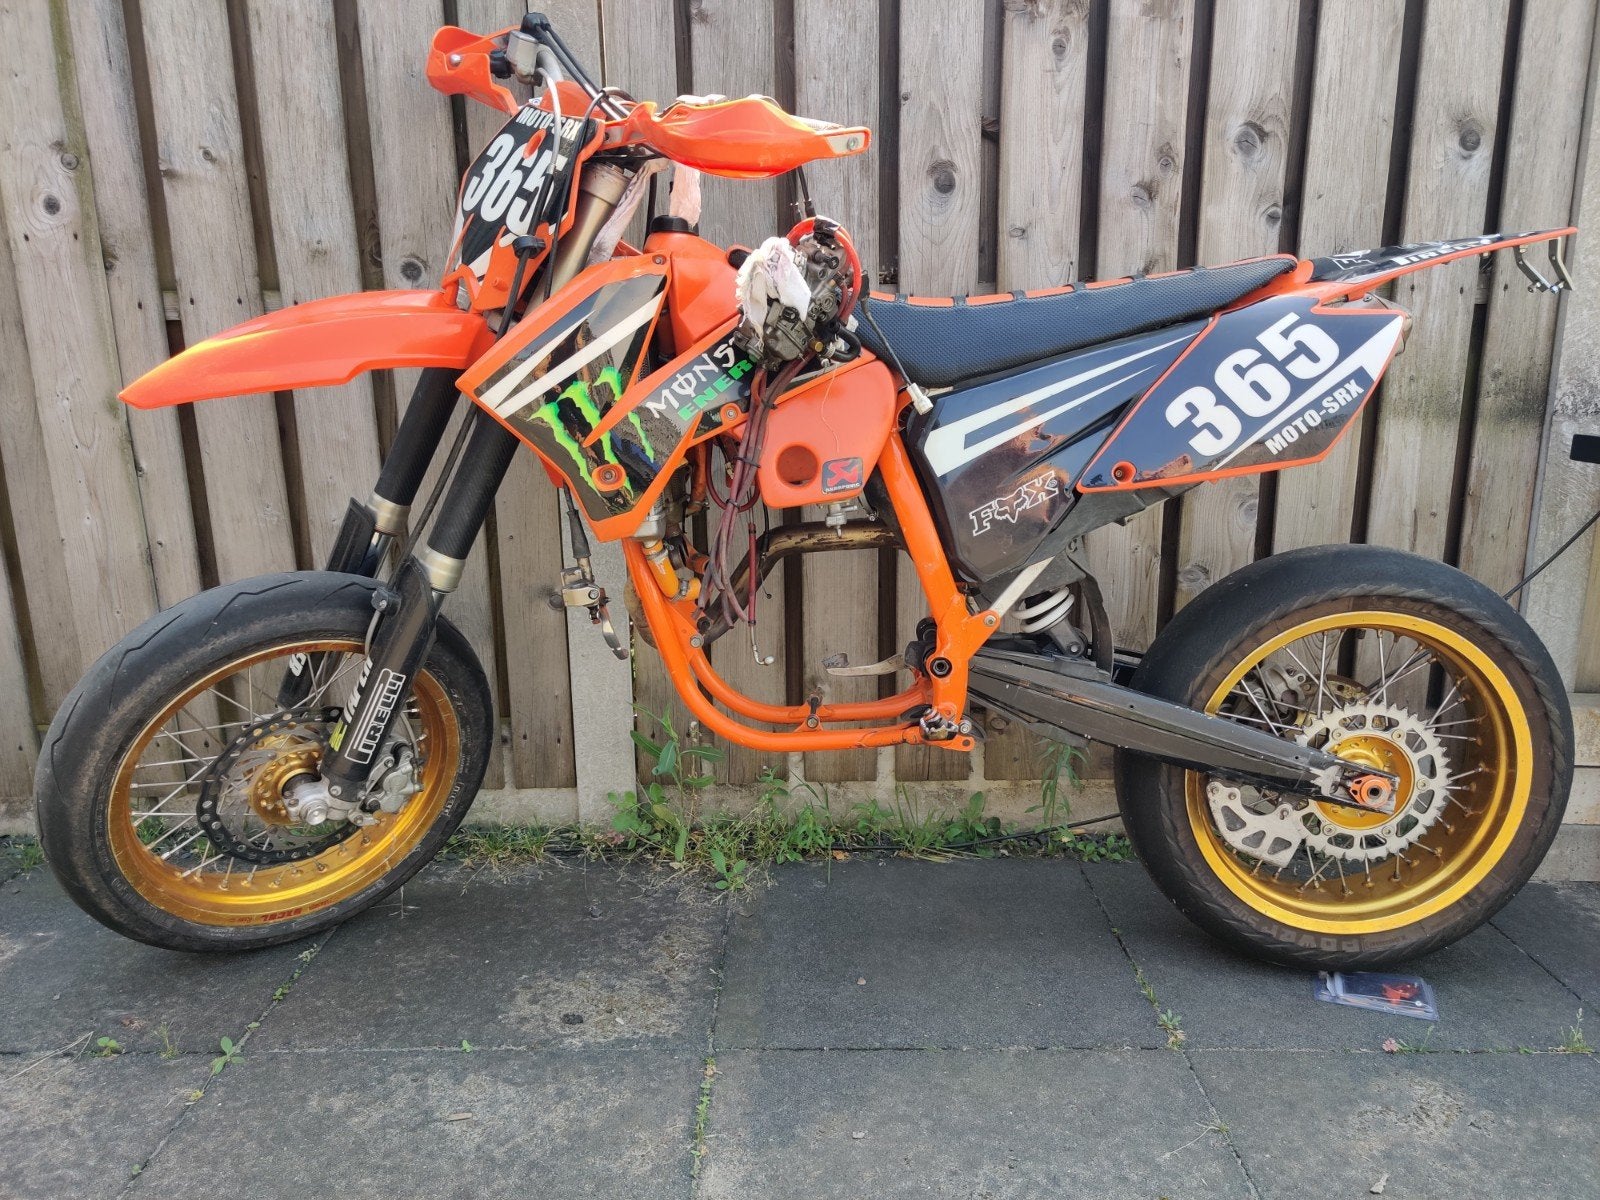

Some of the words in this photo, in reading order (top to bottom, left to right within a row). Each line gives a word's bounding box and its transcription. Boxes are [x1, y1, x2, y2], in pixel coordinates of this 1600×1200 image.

[463, 133, 568, 236] 365
[645, 337, 736, 418] MONS
[1165, 312, 1340, 457] 365
[1264, 379, 1364, 455] MOTO-SRX
[344, 668, 406, 764] PIRELLI
